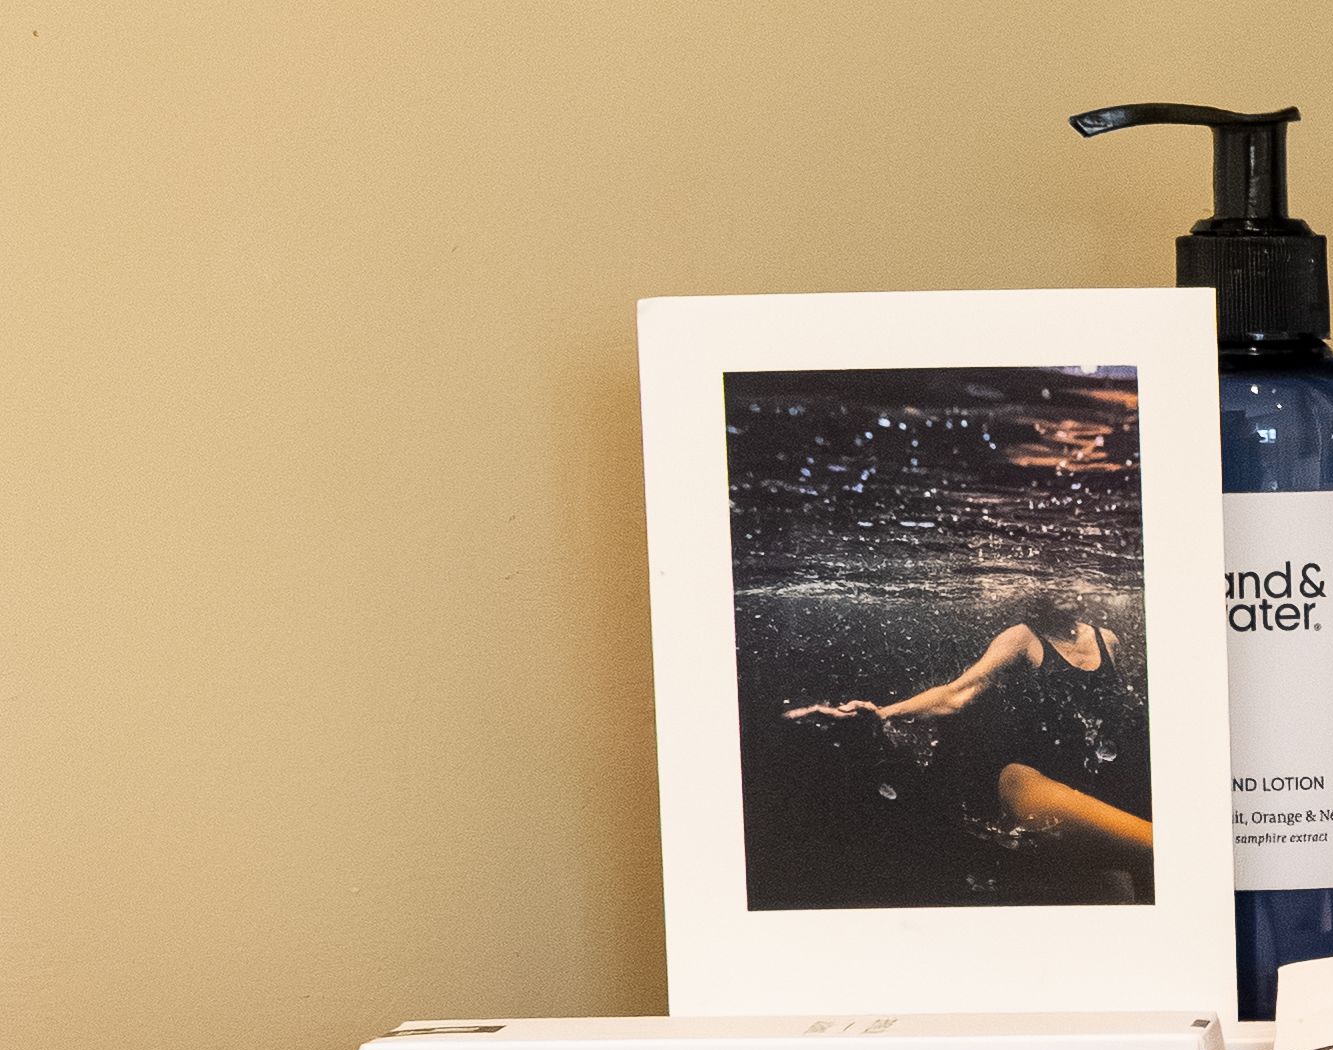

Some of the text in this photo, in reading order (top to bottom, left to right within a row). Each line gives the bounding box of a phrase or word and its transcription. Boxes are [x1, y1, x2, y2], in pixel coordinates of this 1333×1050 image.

[1262, 775, 1325, 792] LOTION
[1251, 811, 1302, 826] Orange
[1305, 810, 1317, 822] &
[1235, 832, 1328, 846] samphire extract
